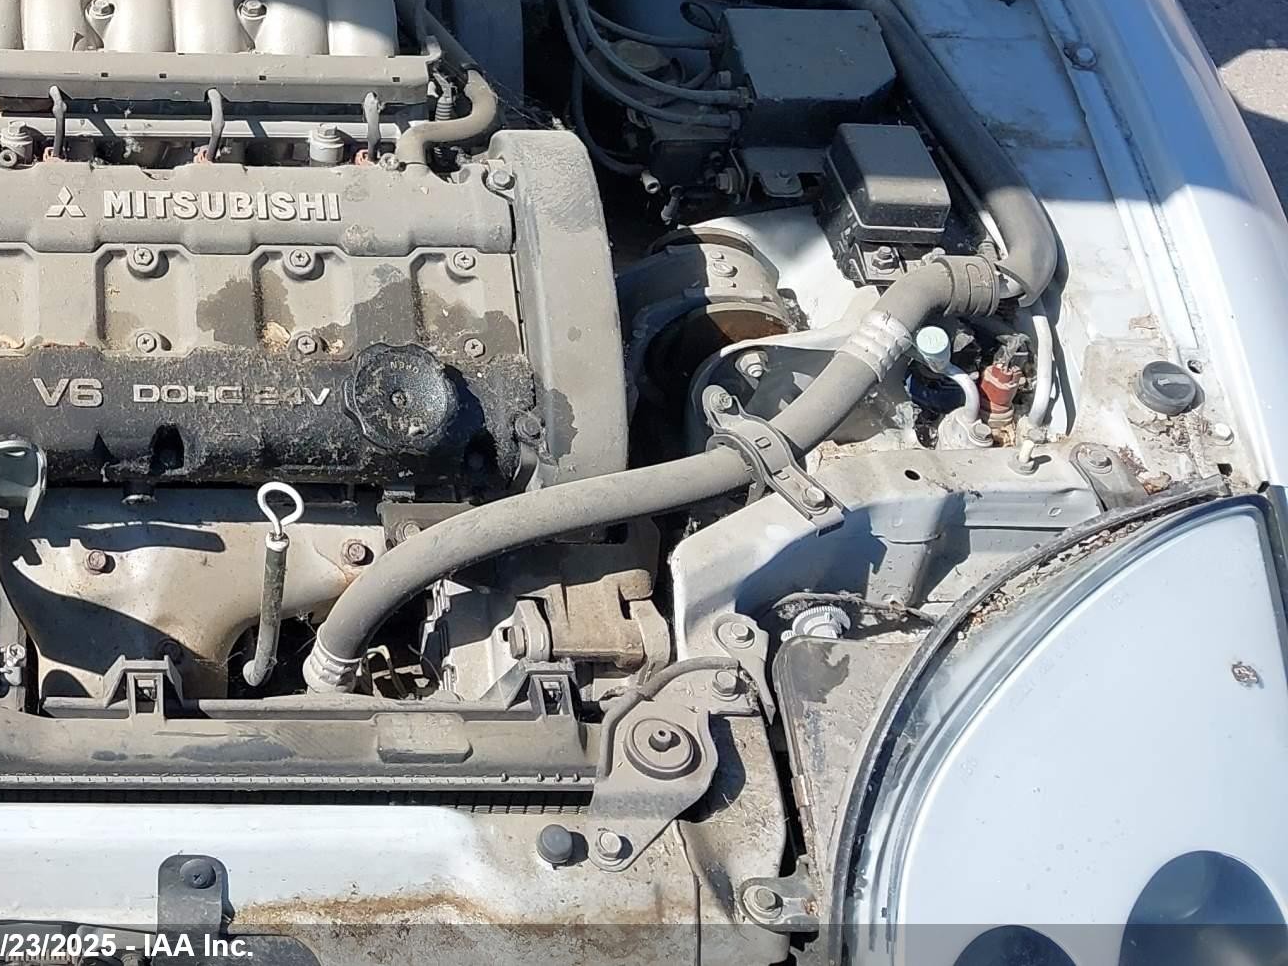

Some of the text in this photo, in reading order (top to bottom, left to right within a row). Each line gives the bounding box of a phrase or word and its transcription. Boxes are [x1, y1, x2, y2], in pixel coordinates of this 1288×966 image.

[103, 190, 342, 222] MITSUBISHI
[33, 378, 331, 407] V6 DOHC 24V
